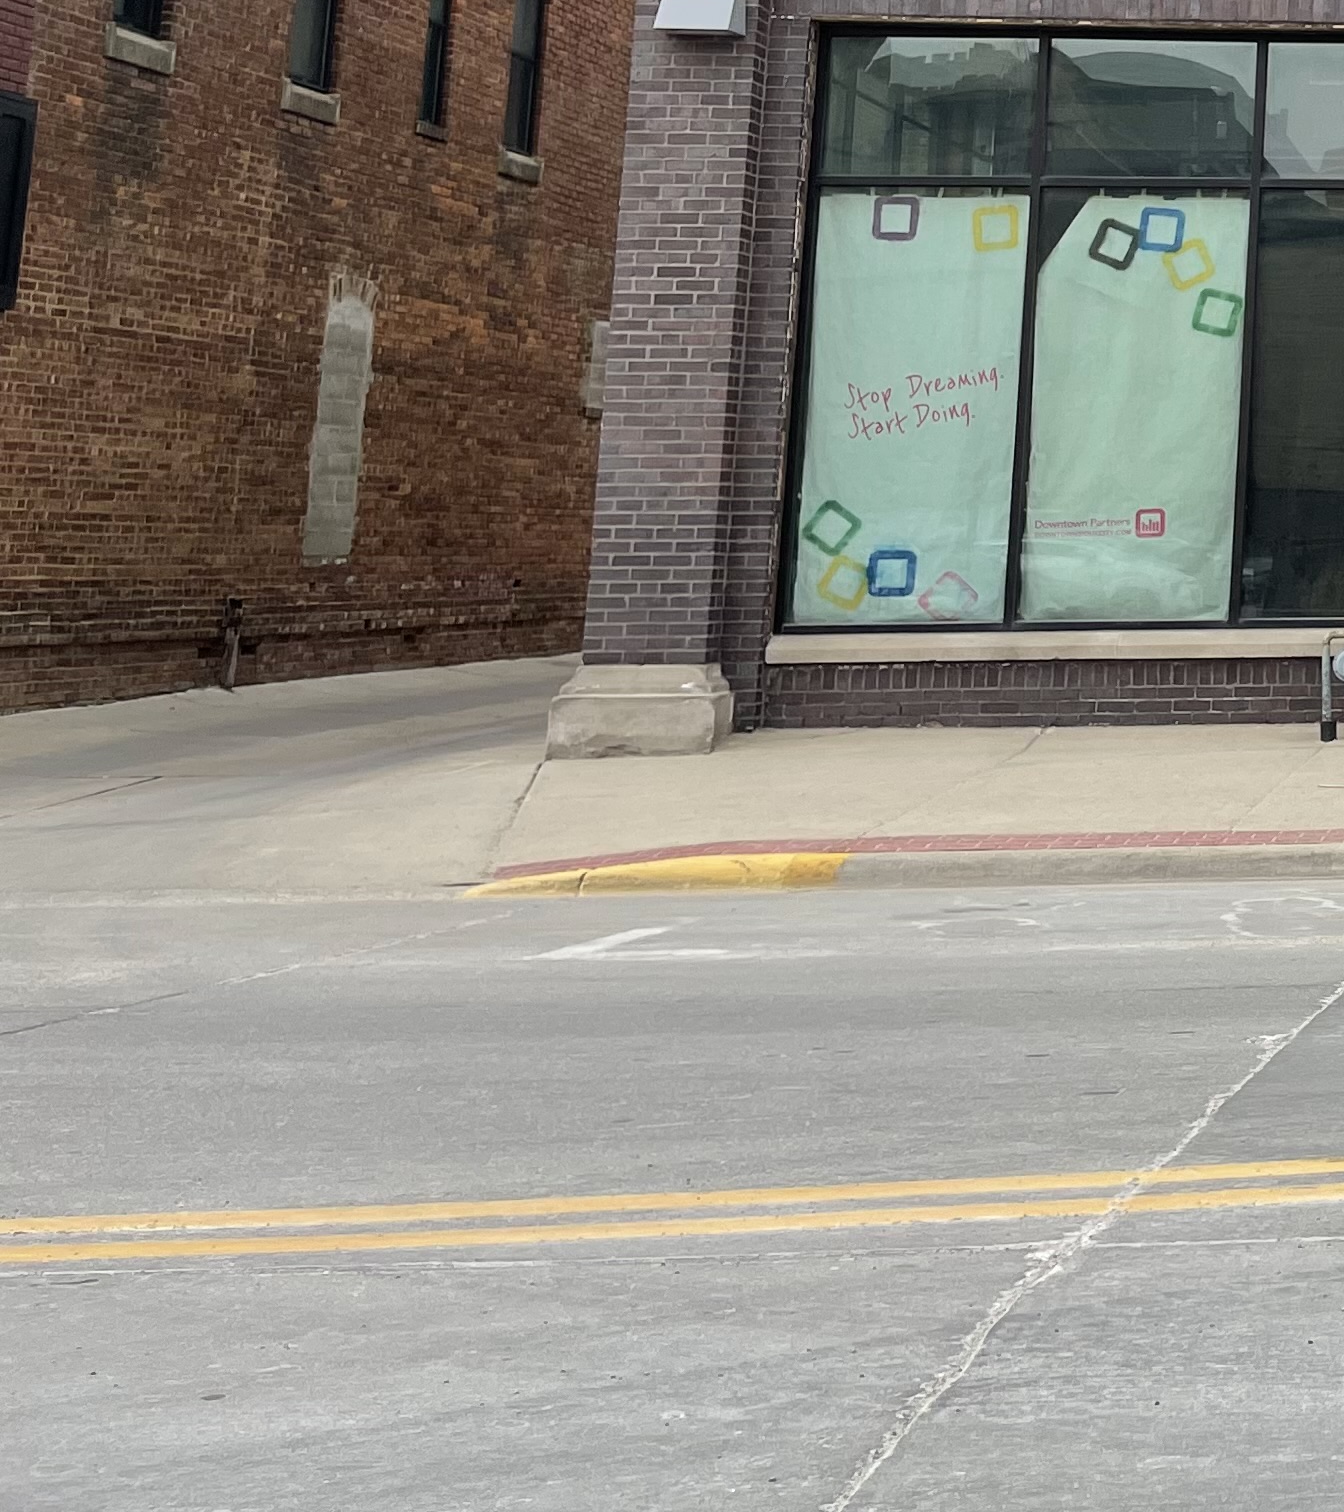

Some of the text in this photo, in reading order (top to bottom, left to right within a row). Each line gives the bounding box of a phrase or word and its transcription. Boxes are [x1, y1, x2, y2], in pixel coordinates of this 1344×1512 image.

[844, 383, 892, 412] Stop
[848, 402, 976, 440] Start Doing.
[1034, 518, 1131, 529] Downtown Partners
